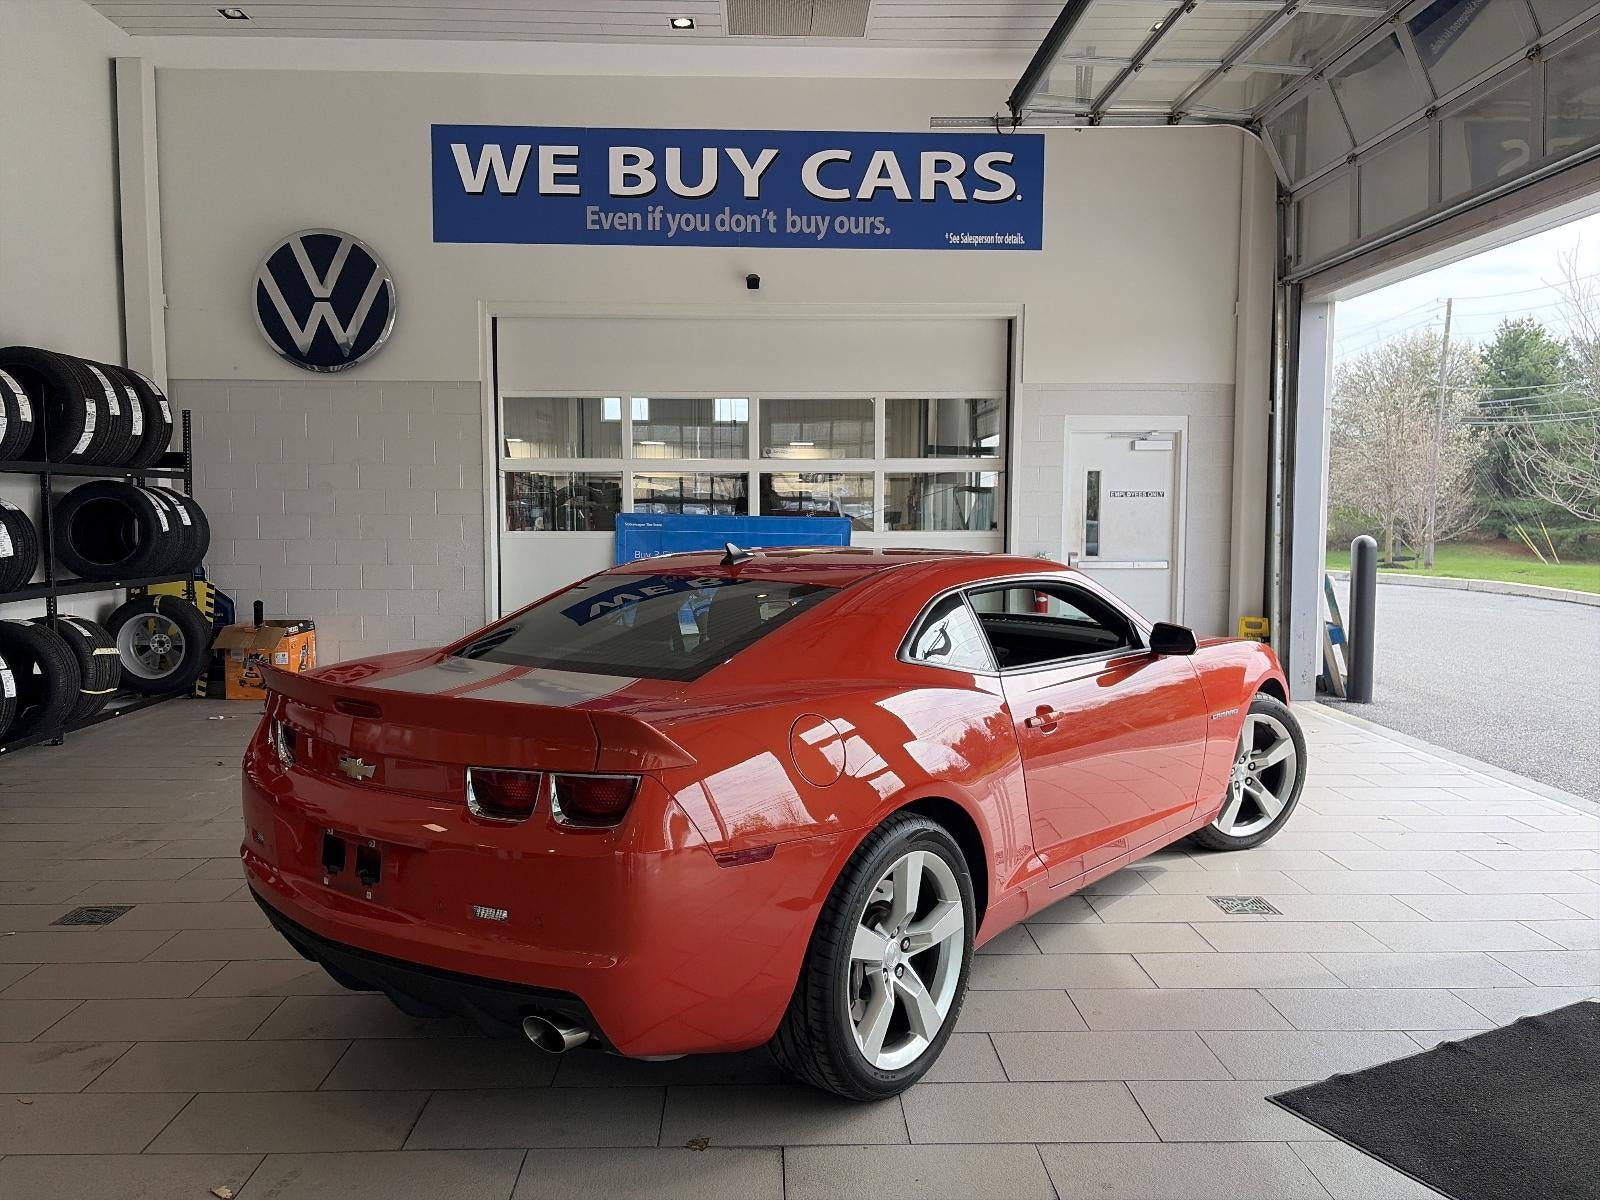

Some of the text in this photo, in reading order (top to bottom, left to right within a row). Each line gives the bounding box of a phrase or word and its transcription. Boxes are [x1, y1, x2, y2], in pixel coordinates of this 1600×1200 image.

[450, 143, 1023, 202] WE BUY CARS.
[586, 205, 891, 241] Even if you don't buy ours.
[960, 232, 995, 247] Salesperson
[995, 232, 1004, 244] for
[1109, 490, 1165, 498] EMPLOYEES ONLY
[1212, 708, 1239, 720] CAMARO
